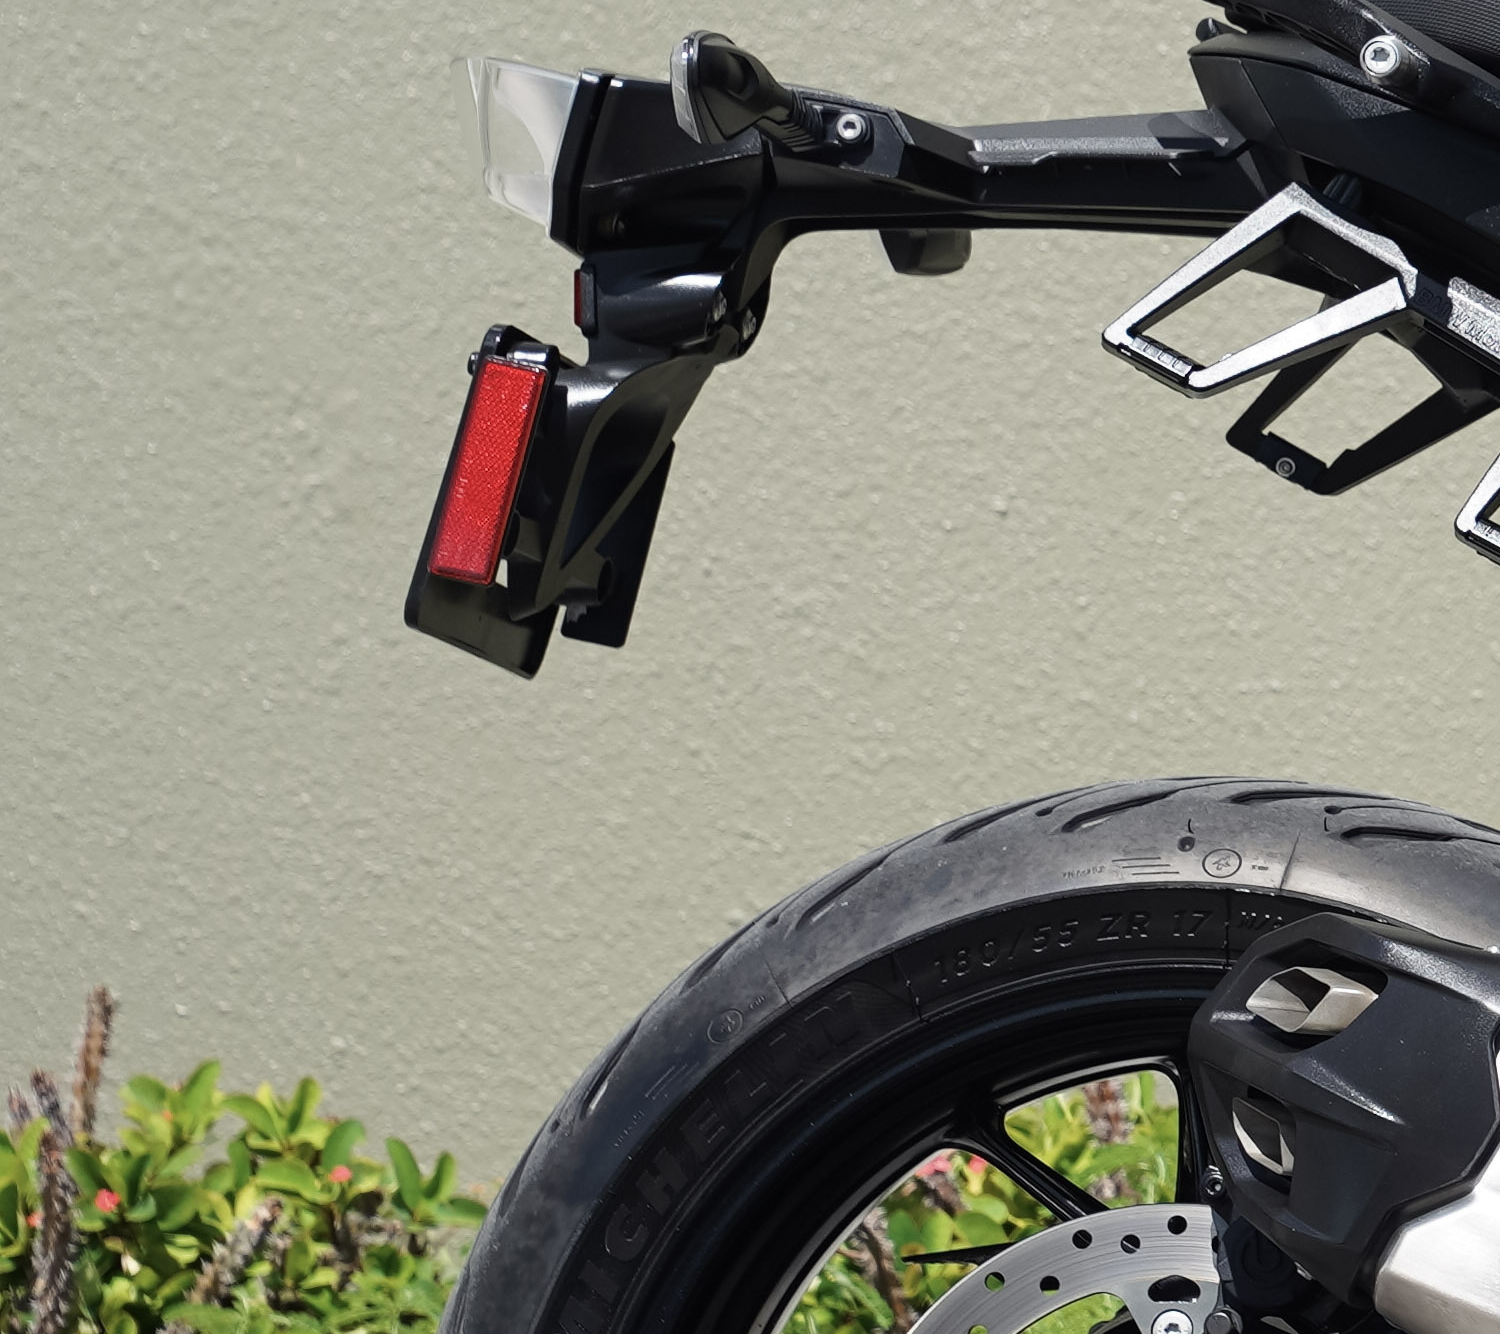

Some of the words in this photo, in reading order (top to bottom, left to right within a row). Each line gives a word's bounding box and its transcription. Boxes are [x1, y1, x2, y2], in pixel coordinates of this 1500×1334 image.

[932, 915, 1080, 983] 180/55
[1093, 909, 1149, 942] ZR
[1171, 907, 1213, 939] 17
